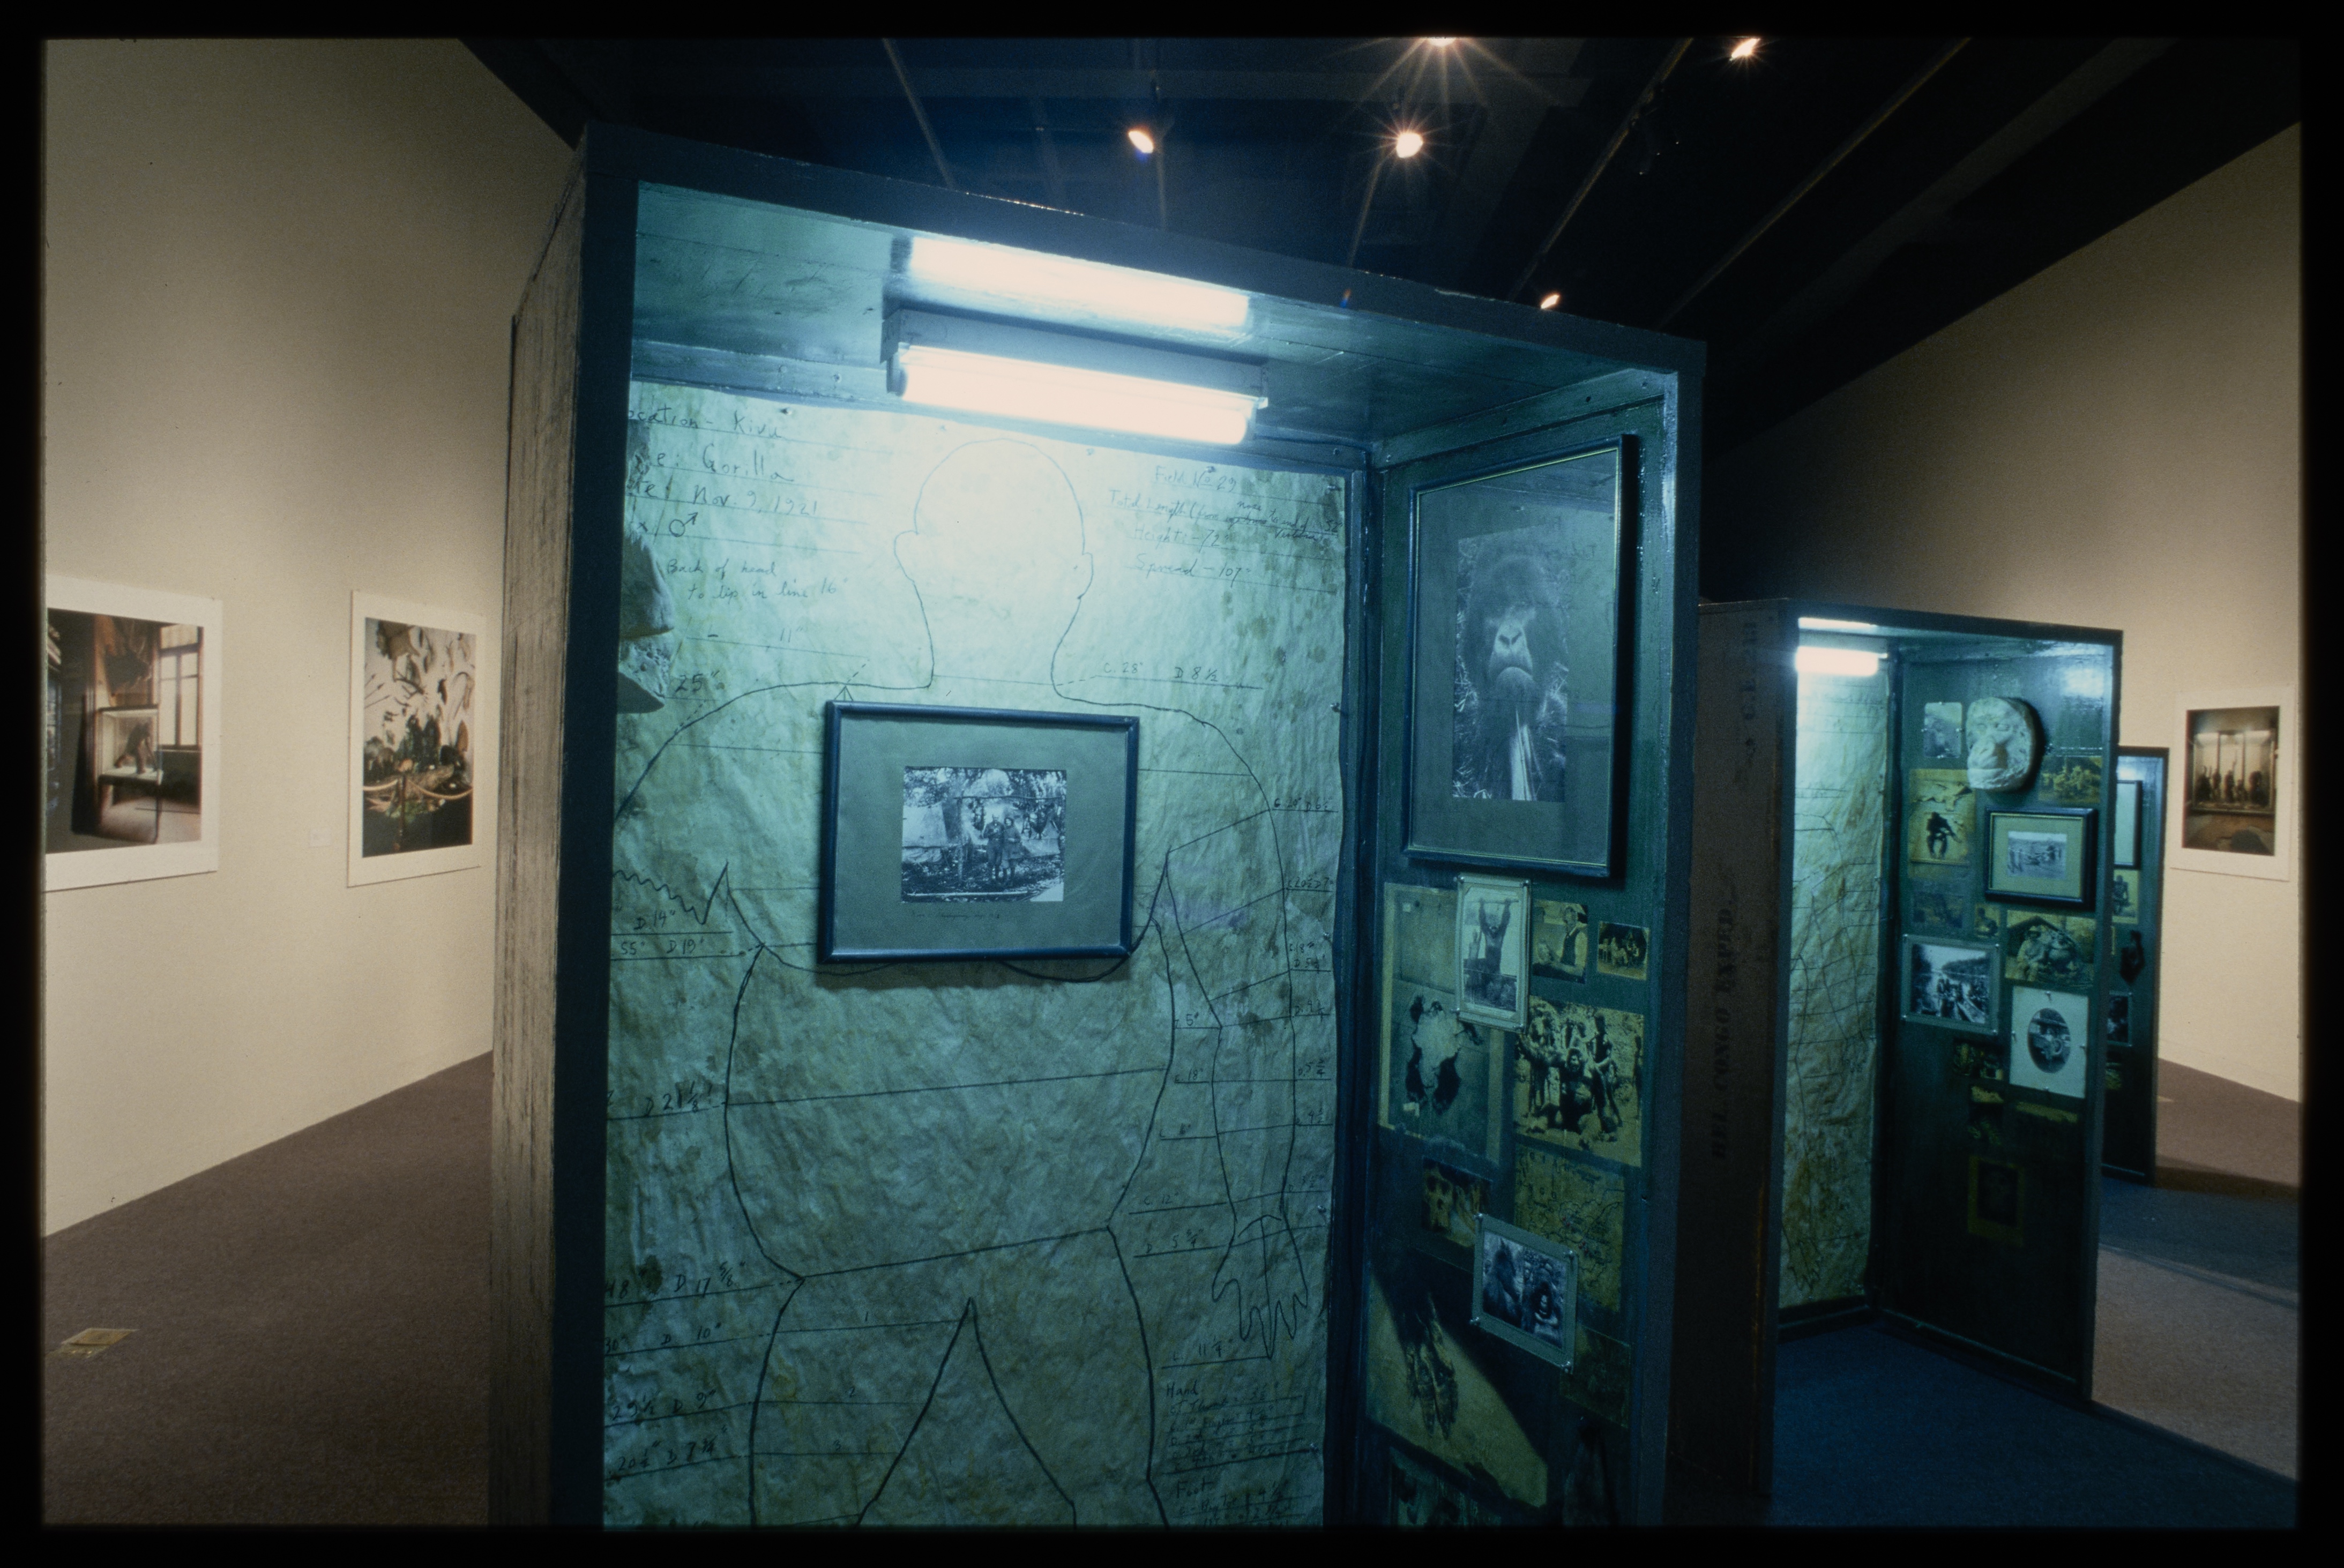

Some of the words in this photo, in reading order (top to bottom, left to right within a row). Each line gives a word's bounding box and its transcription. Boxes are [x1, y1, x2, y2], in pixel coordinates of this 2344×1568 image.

[628, 405, 699, 429] ocation
[734, 409, 782, 438] Kivu
[703, 443, 794, 482] Gorilla
[1217, 475, 1237, 492] 29
[774, 495, 818, 516] 1921
[1109, 490, 1141, 508] Total
[667, 559, 704, 574] Back
[715, 558, 729, 580] of
[741, 561, 777, 576] head
[1137, 552, 1195, 579] Spread
[688, 584, 705, 600] to
[751, 582, 768, 599] in
[1175, 667, 1184, 678] D
[667, 940, 677, 954] D
[674, 1274, 686, 1293] D
[696, 1278, 711, 1298] 17
[1166, 1379, 1199, 1398] Hand
